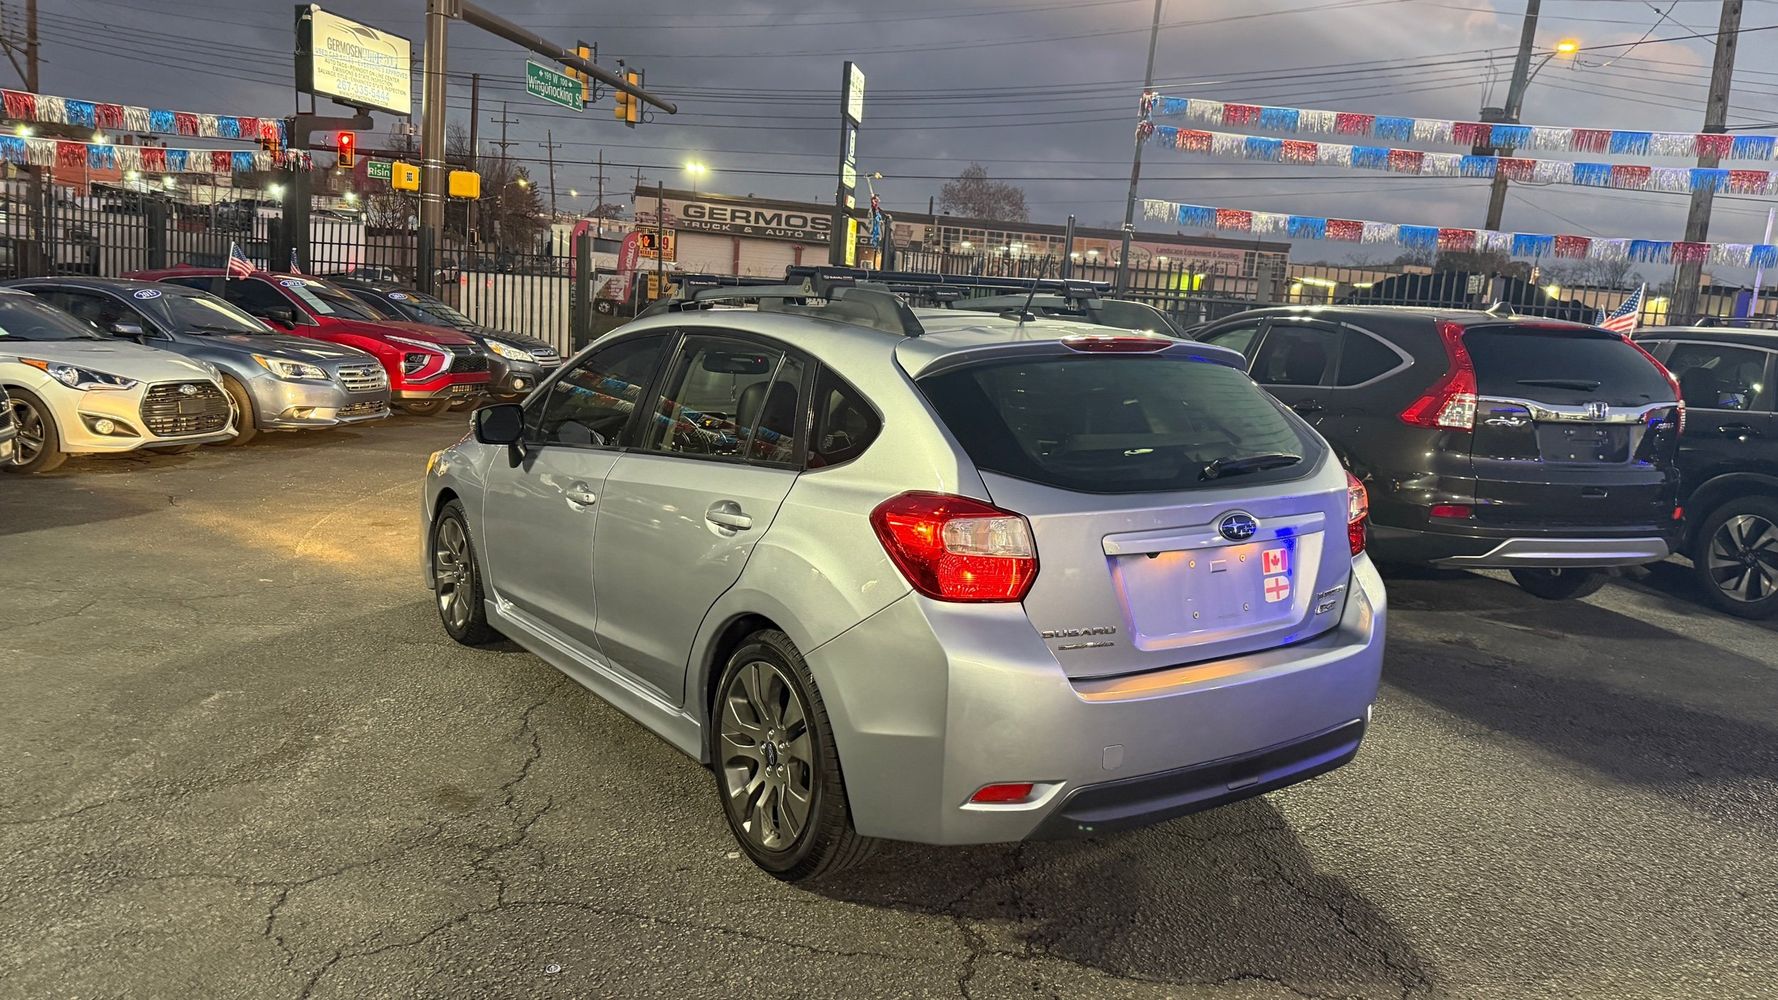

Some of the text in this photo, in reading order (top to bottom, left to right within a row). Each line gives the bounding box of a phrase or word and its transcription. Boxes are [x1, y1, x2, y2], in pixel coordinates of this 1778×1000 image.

[327, 37, 361, 58] GERMOSEN
[553, 74, 559, 84] W
[369, 167, 390, 177] Risin
[683, 204, 874, 234] GERMOSN
[682, 220, 731, 231] TRUCK
[765, 229, 804, 237] AUTO
[1042, 626, 1116, 639] SUBARU
